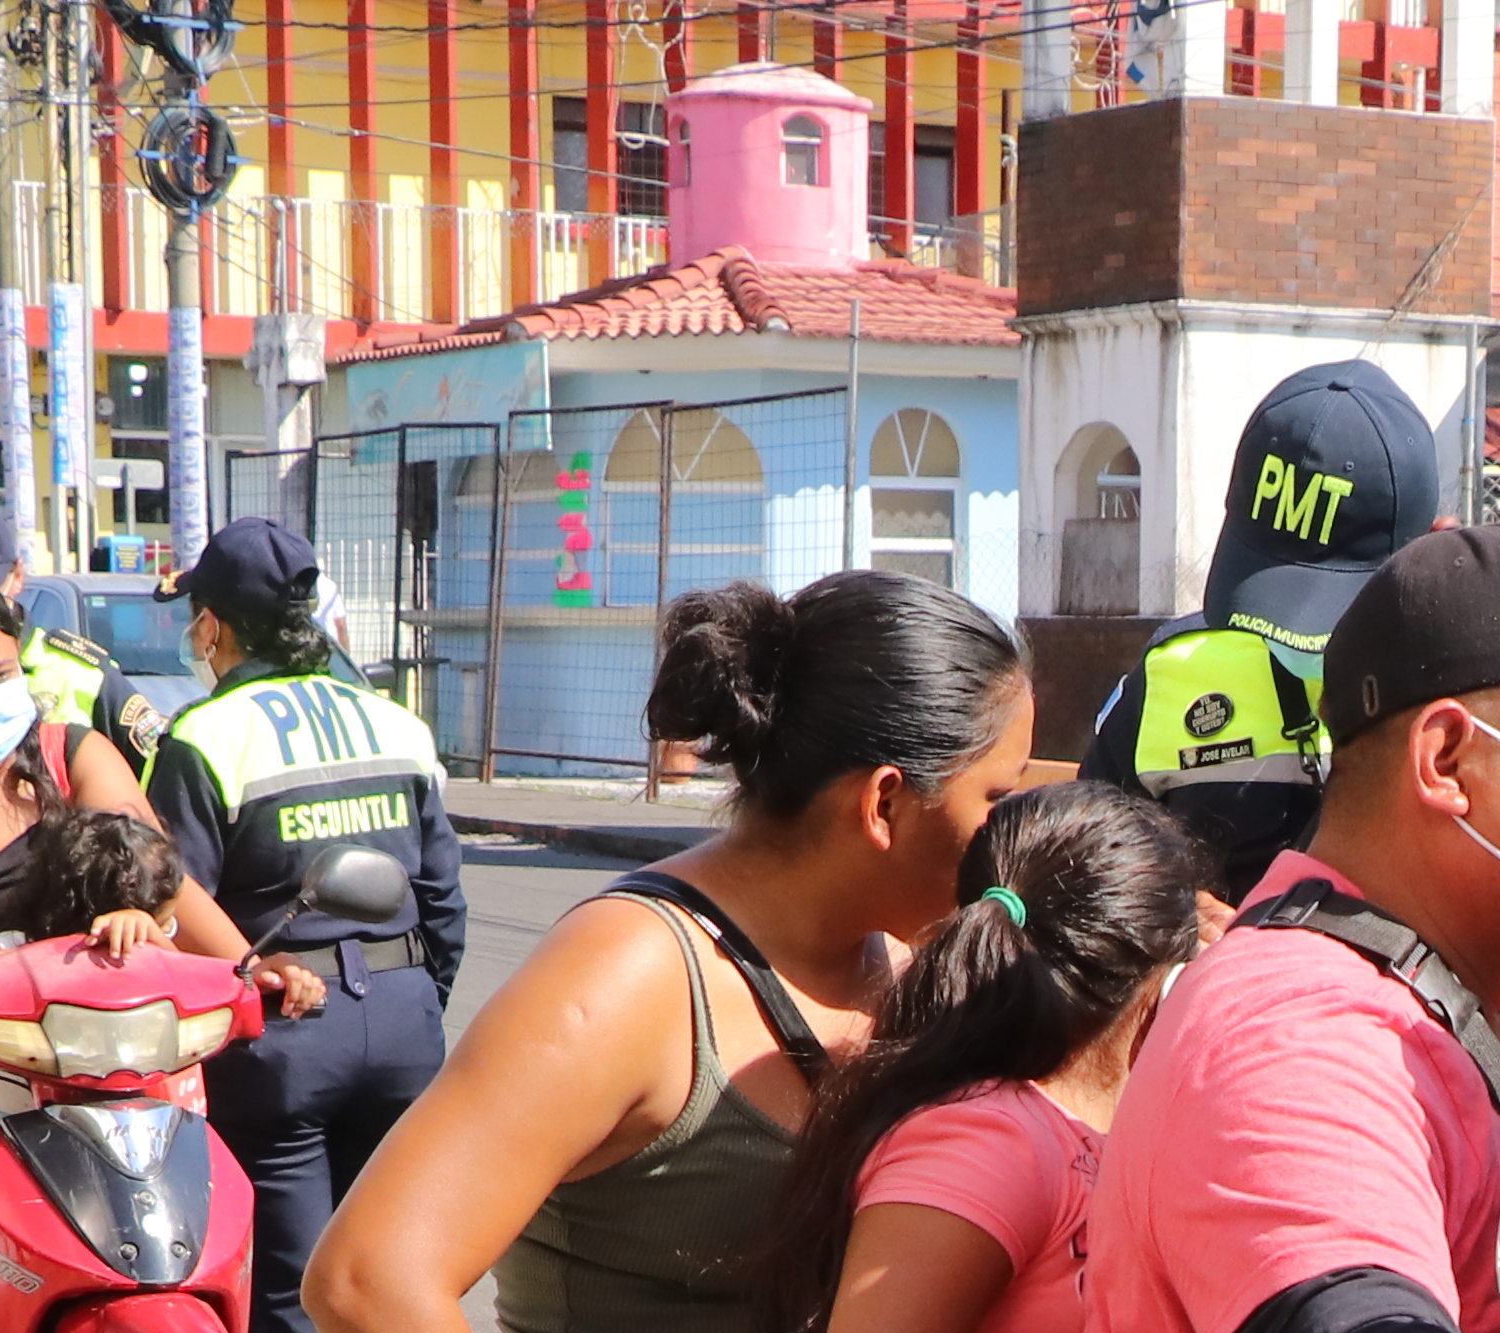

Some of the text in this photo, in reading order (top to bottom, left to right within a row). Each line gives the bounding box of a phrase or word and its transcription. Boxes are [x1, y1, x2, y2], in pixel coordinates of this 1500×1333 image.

[1251, 453, 1354, 545] PMT
[1228, 612, 1274, 638] POLICIA
[250, 677, 383, 767] PMT
[1221, 744, 1251, 759] AVELAR
[278, 792, 410, 843] ESCUINTLA
